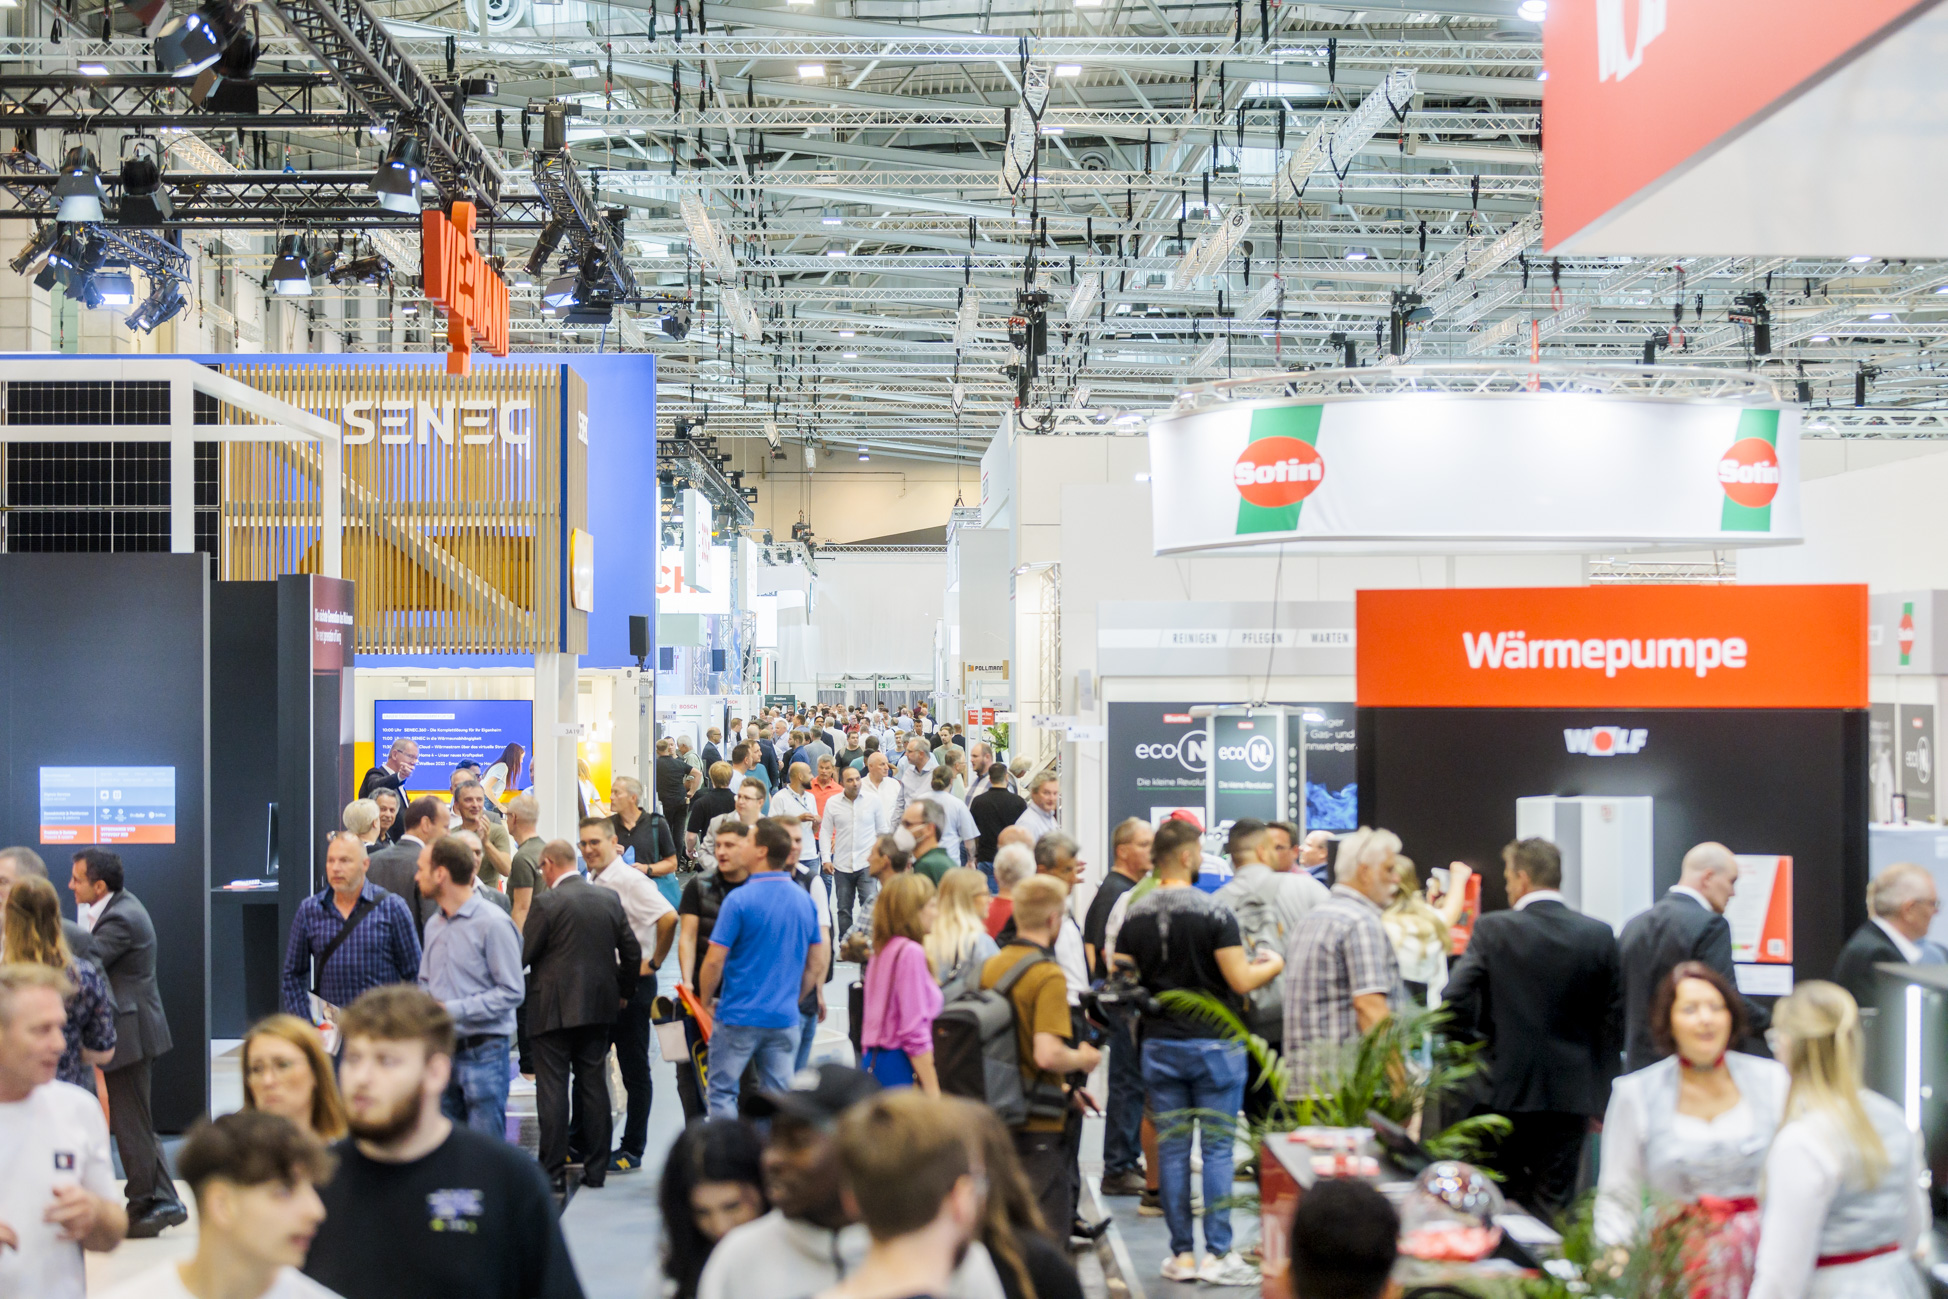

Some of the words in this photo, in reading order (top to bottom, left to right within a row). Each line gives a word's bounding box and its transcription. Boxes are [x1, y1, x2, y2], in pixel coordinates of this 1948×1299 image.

[343, 400, 530, 445] SENEC
[1172, 632, 1218, 644] REINIGEN
[1242, 632, 1283, 644] PFLEGEN
[1310, 632, 1350, 644] WARTEN
[1462, 630, 1748, 678] Wärmepumpe
[1334, 729, 1356, 739] und
[1563, 726, 1649, 757] WOLF
[1136, 777, 1151, 786] Die
[1151, 777, 1176, 786] kleine
[1176, 777, 1207, 786] Revolut
